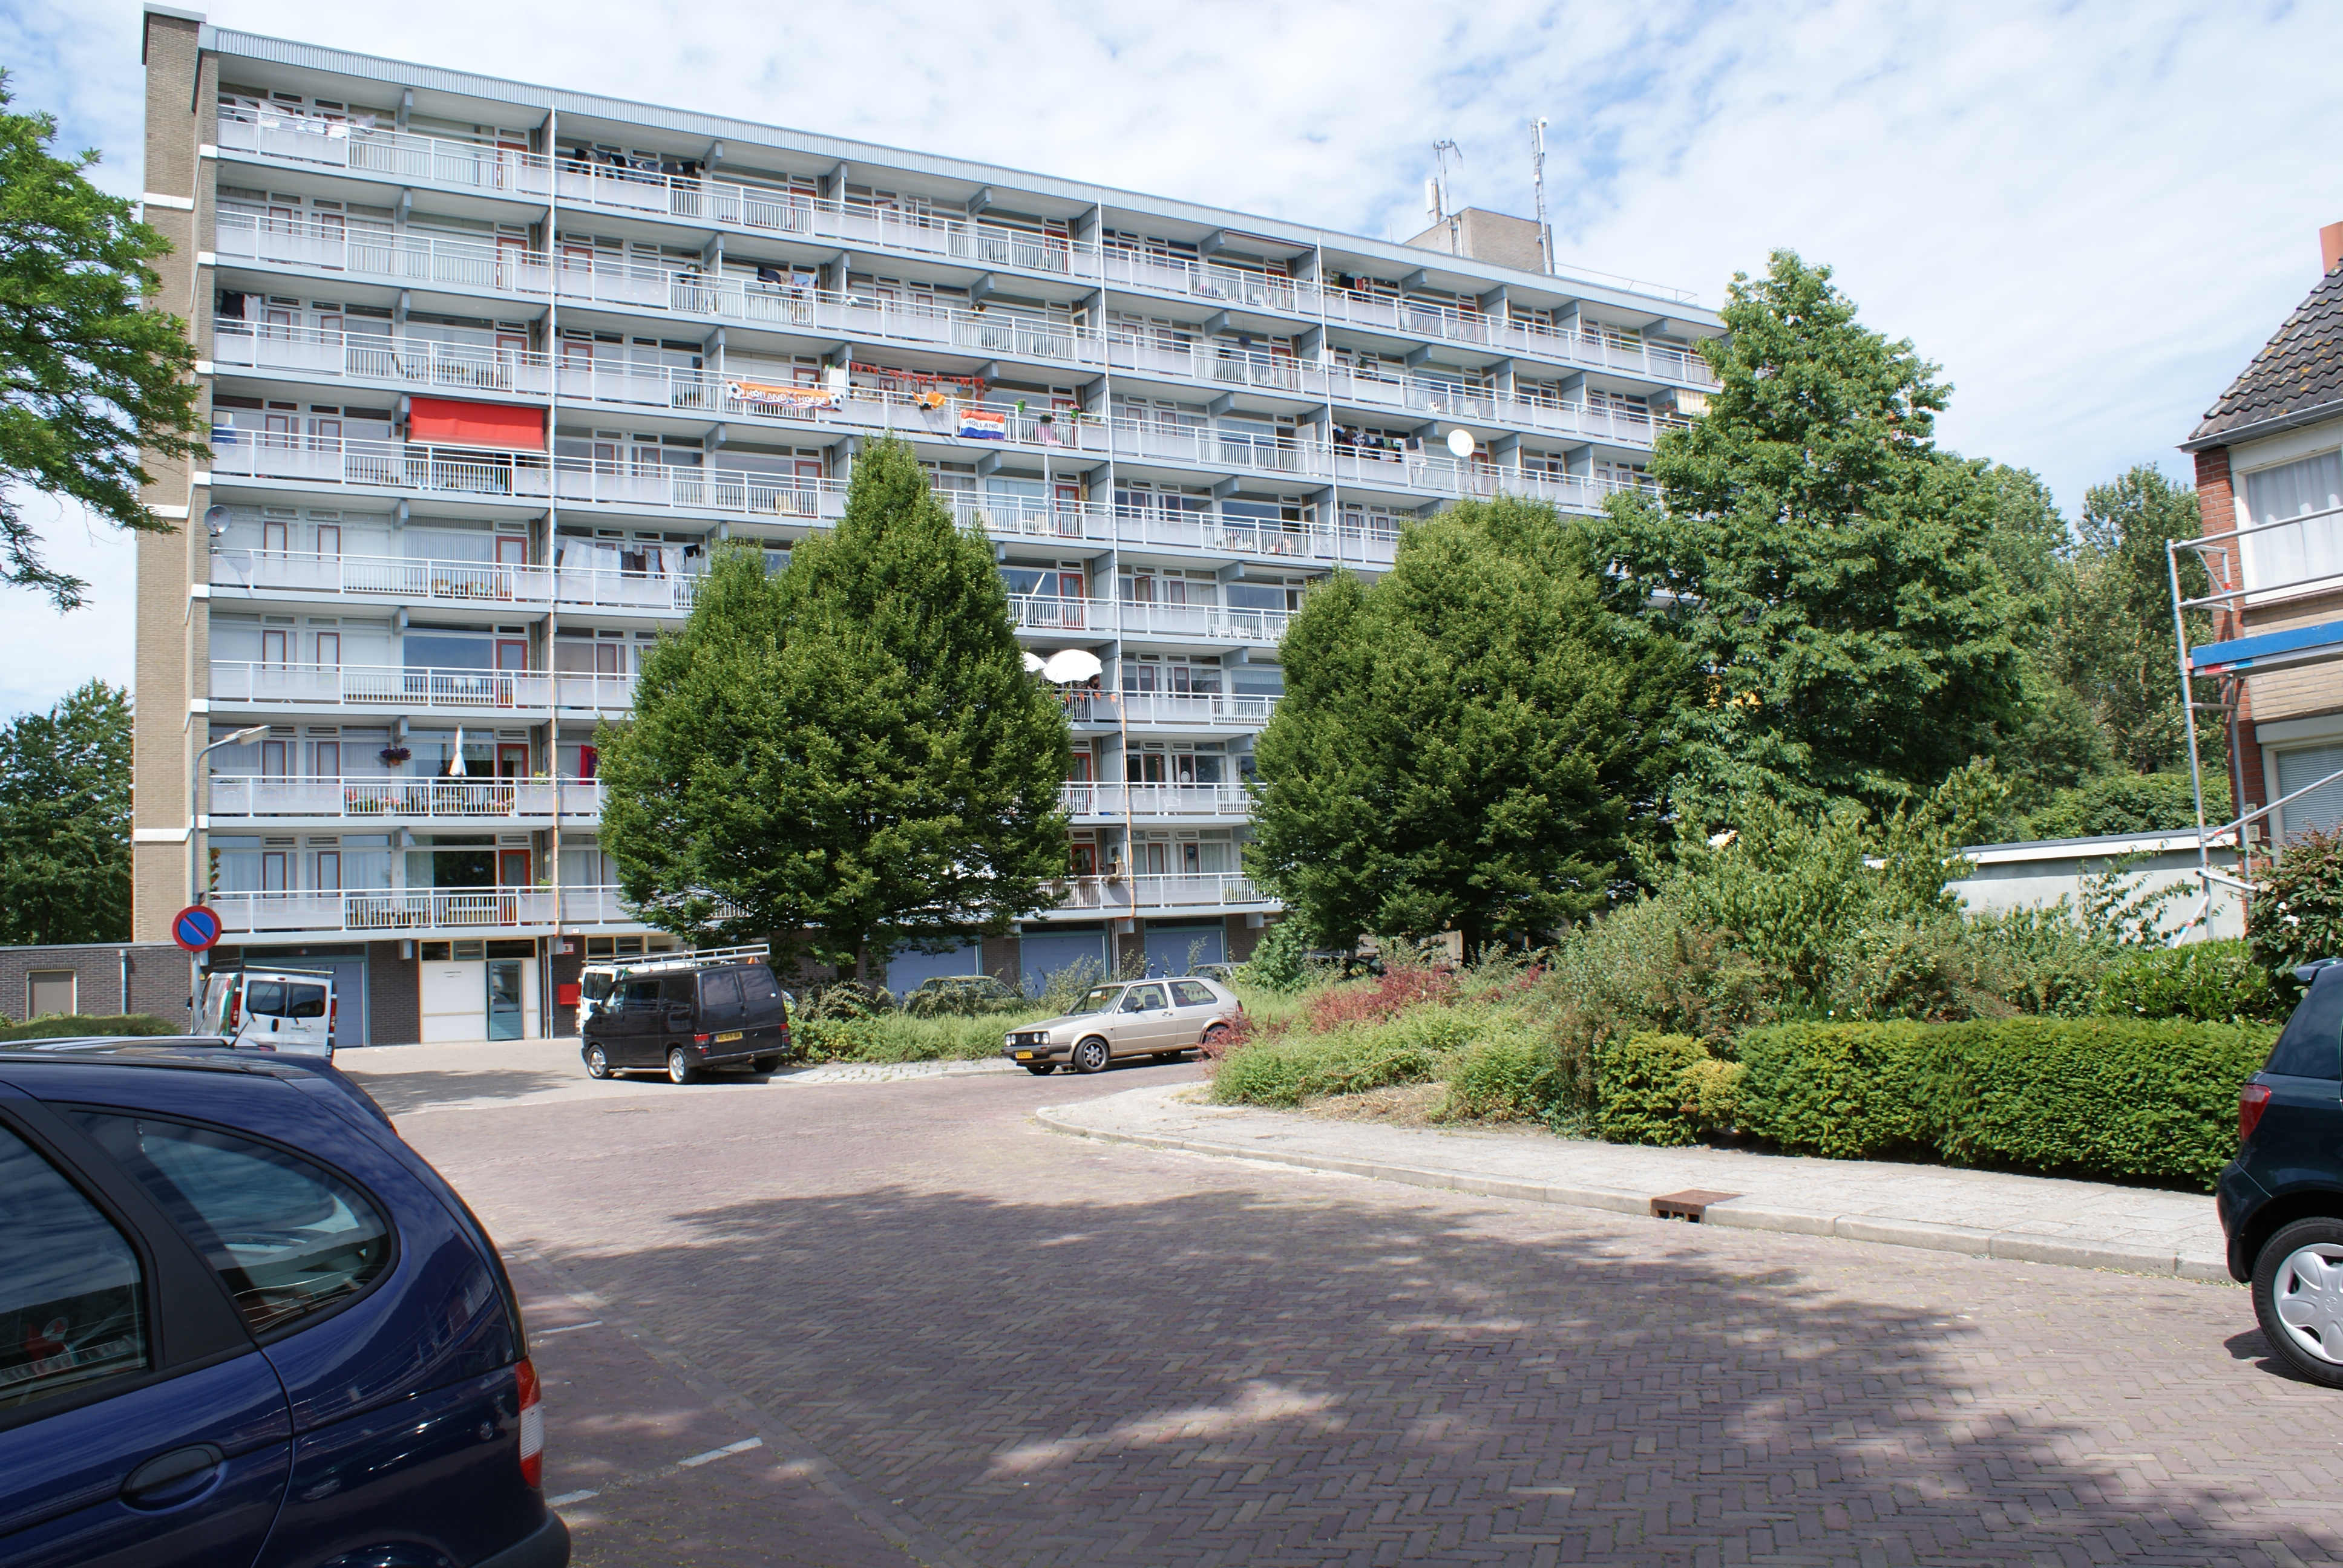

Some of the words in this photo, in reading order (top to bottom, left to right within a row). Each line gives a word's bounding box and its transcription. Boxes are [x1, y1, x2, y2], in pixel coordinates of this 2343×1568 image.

[745, 389, 786, 402] HOLLAND
[798, 394, 828, 404] HOUSE
[966, 419, 998, 429] HOLLAND
